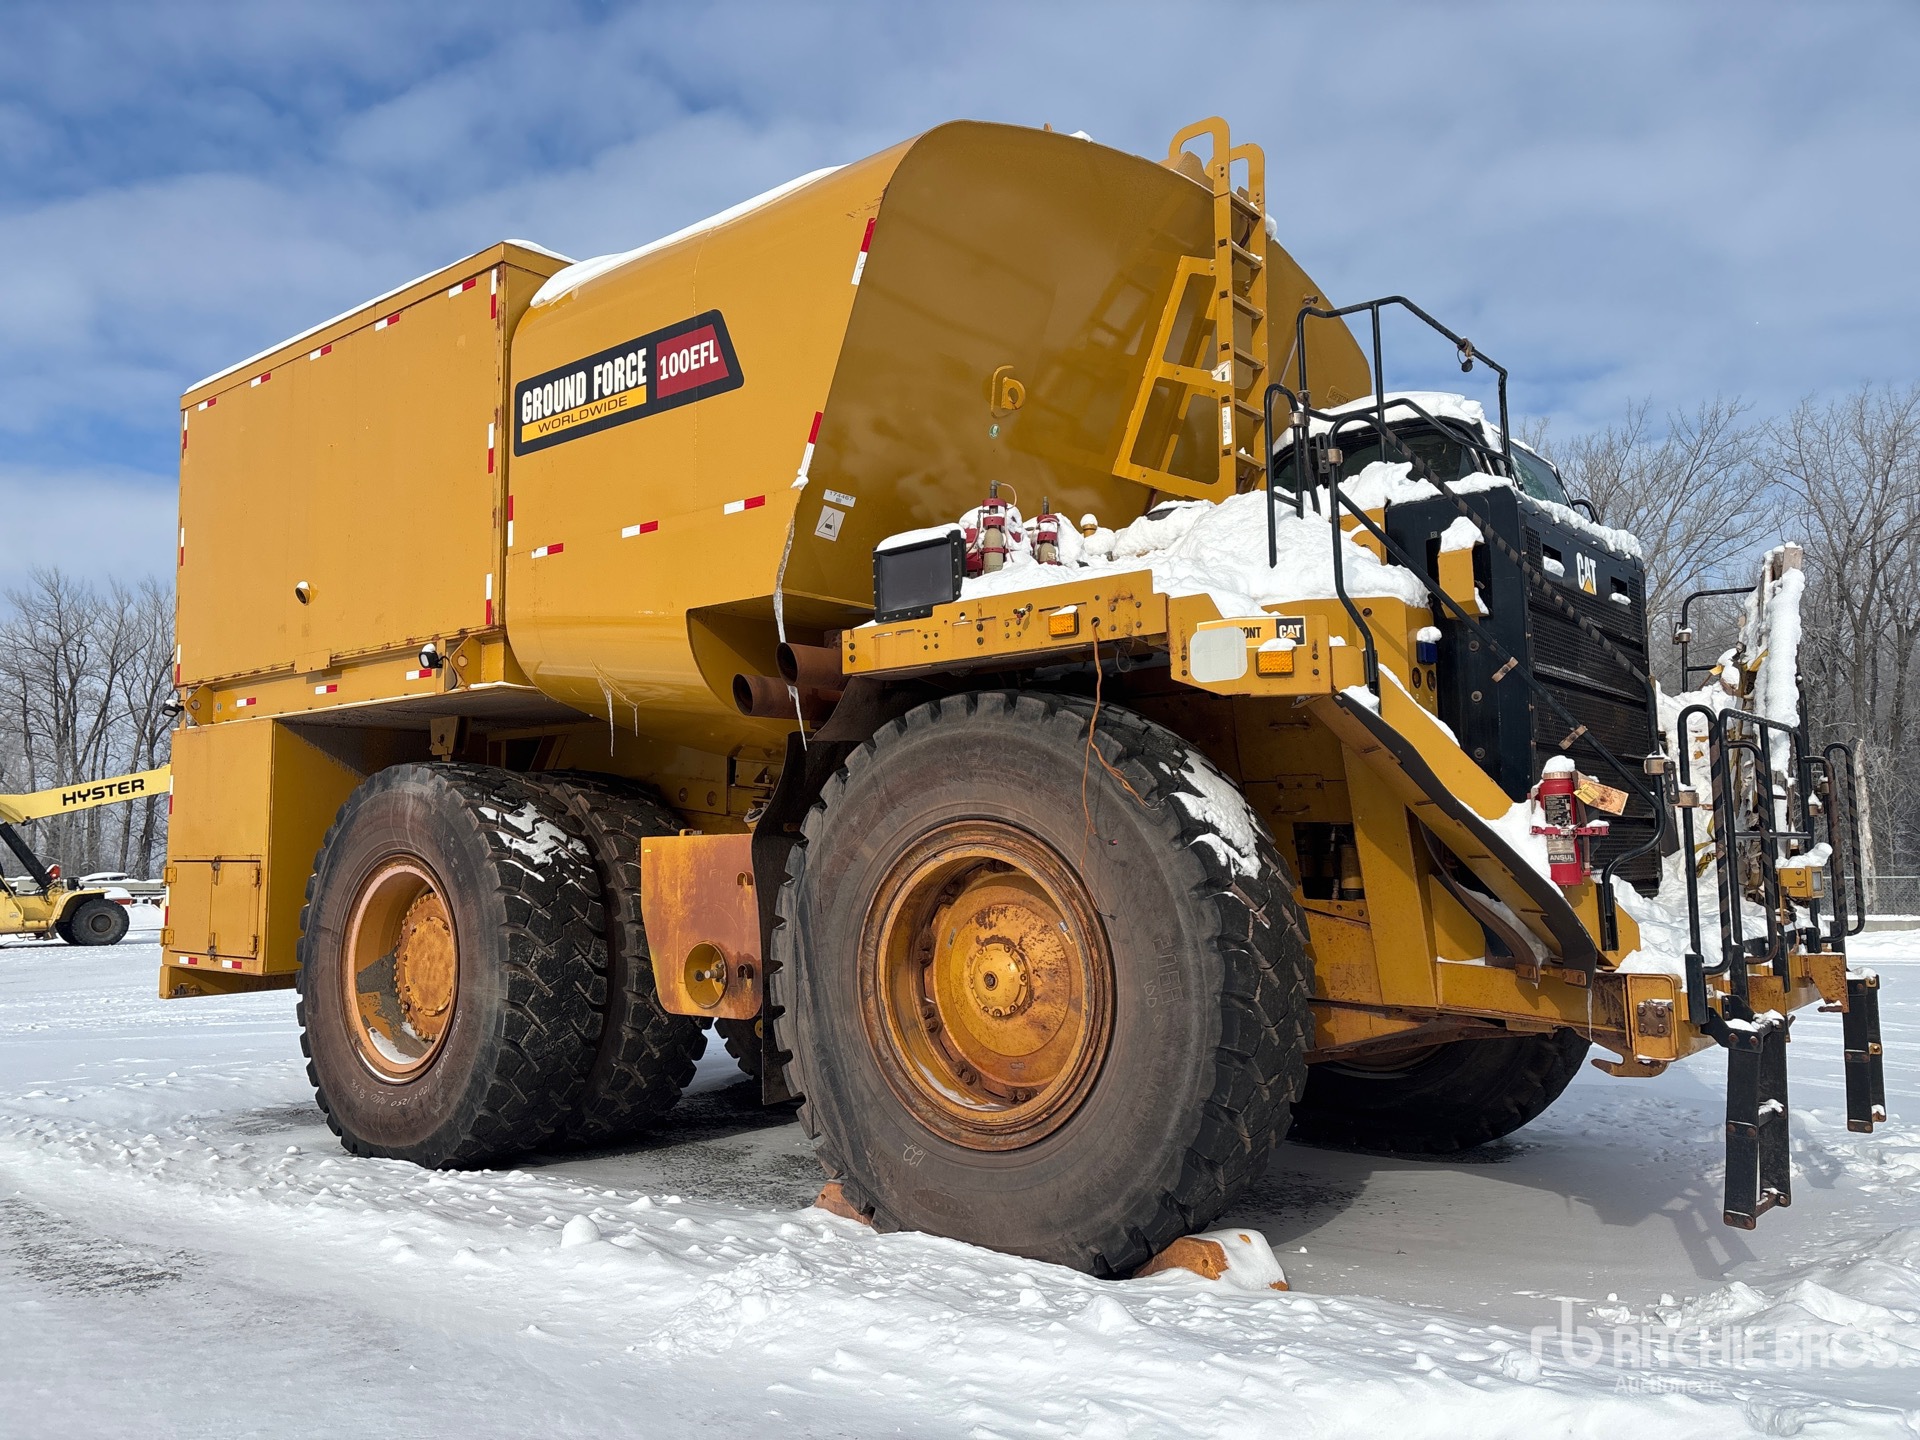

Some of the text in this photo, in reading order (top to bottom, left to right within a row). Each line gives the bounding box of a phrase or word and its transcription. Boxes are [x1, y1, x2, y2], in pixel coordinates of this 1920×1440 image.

[521, 339, 719, 424] GROUND FORCE 100EFL
[537, 395, 628, 434] WORLDWIDE
[1575, 551, 1598, 596] CAT
[1240, 626, 1262, 639] ONT
[1278, 624, 1302, 639] CAT
[62, 778, 145, 806] HYSTER
[1549, 854, 1574, 862] ANSUL
